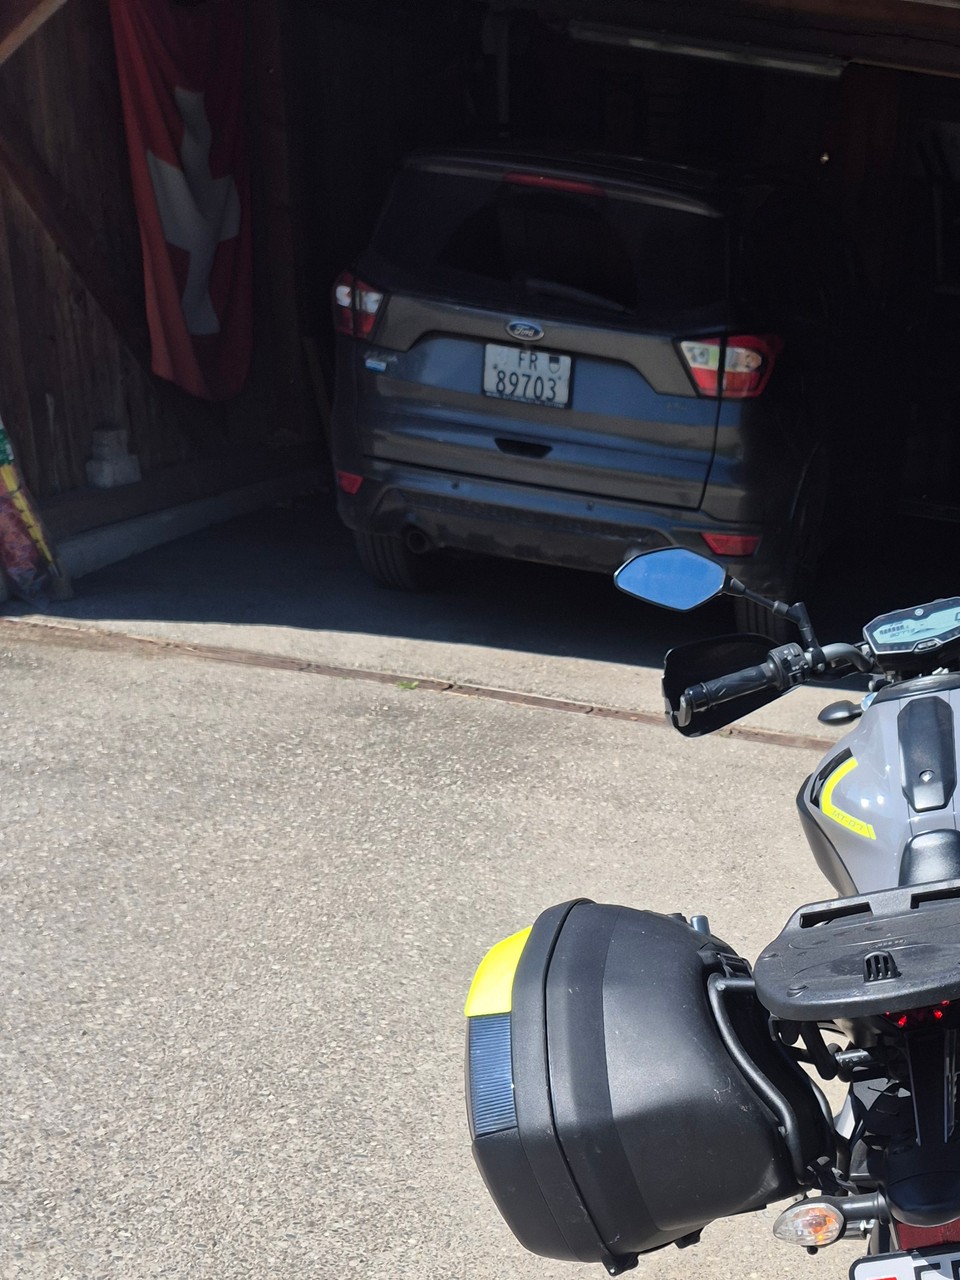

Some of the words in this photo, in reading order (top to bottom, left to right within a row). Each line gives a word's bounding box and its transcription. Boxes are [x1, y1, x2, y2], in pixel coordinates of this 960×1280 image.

[513, 327, 536, 337] Ford
[518, 350, 538, 371] FR
[495, 370, 557, 402] 89703
[831, 809, 864, 832] MT-07
